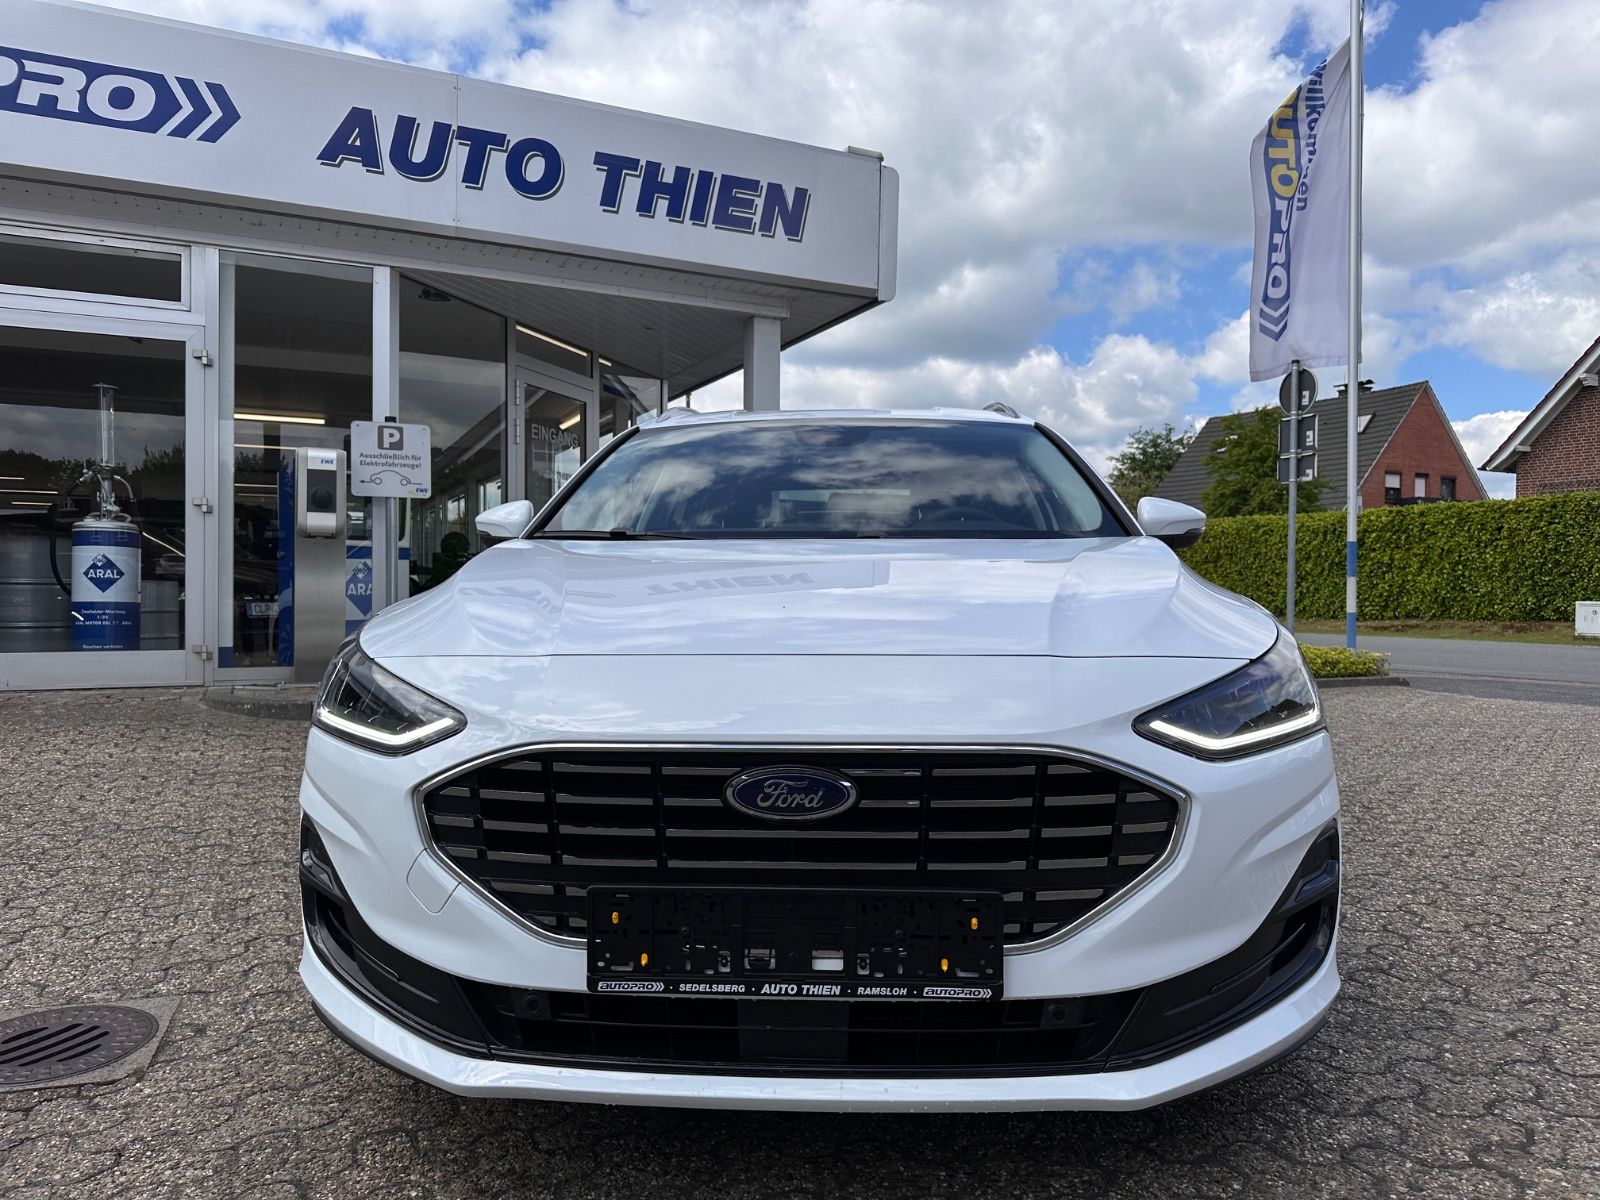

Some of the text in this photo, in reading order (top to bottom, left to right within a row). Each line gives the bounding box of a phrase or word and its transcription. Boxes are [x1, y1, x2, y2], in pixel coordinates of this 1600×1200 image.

[316, 106, 811, 243] AUTO THIEN
[383, 427, 401, 449] P
[531, 423, 579, 447] EINGANG
[359, 452, 411, 461] Ausschließlich
[359, 459, 422, 470] Elektrofahrzeuge!
[87, 569, 120, 579] ARAL
[756, 779, 826, 808] Ford
[679, 983, 746, 993] SEDELSBERG
[760, 983, 798, 995] AUTO
[801, 984, 841, 995] THIEN
[857, 987, 908, 996] RAMSLOH
